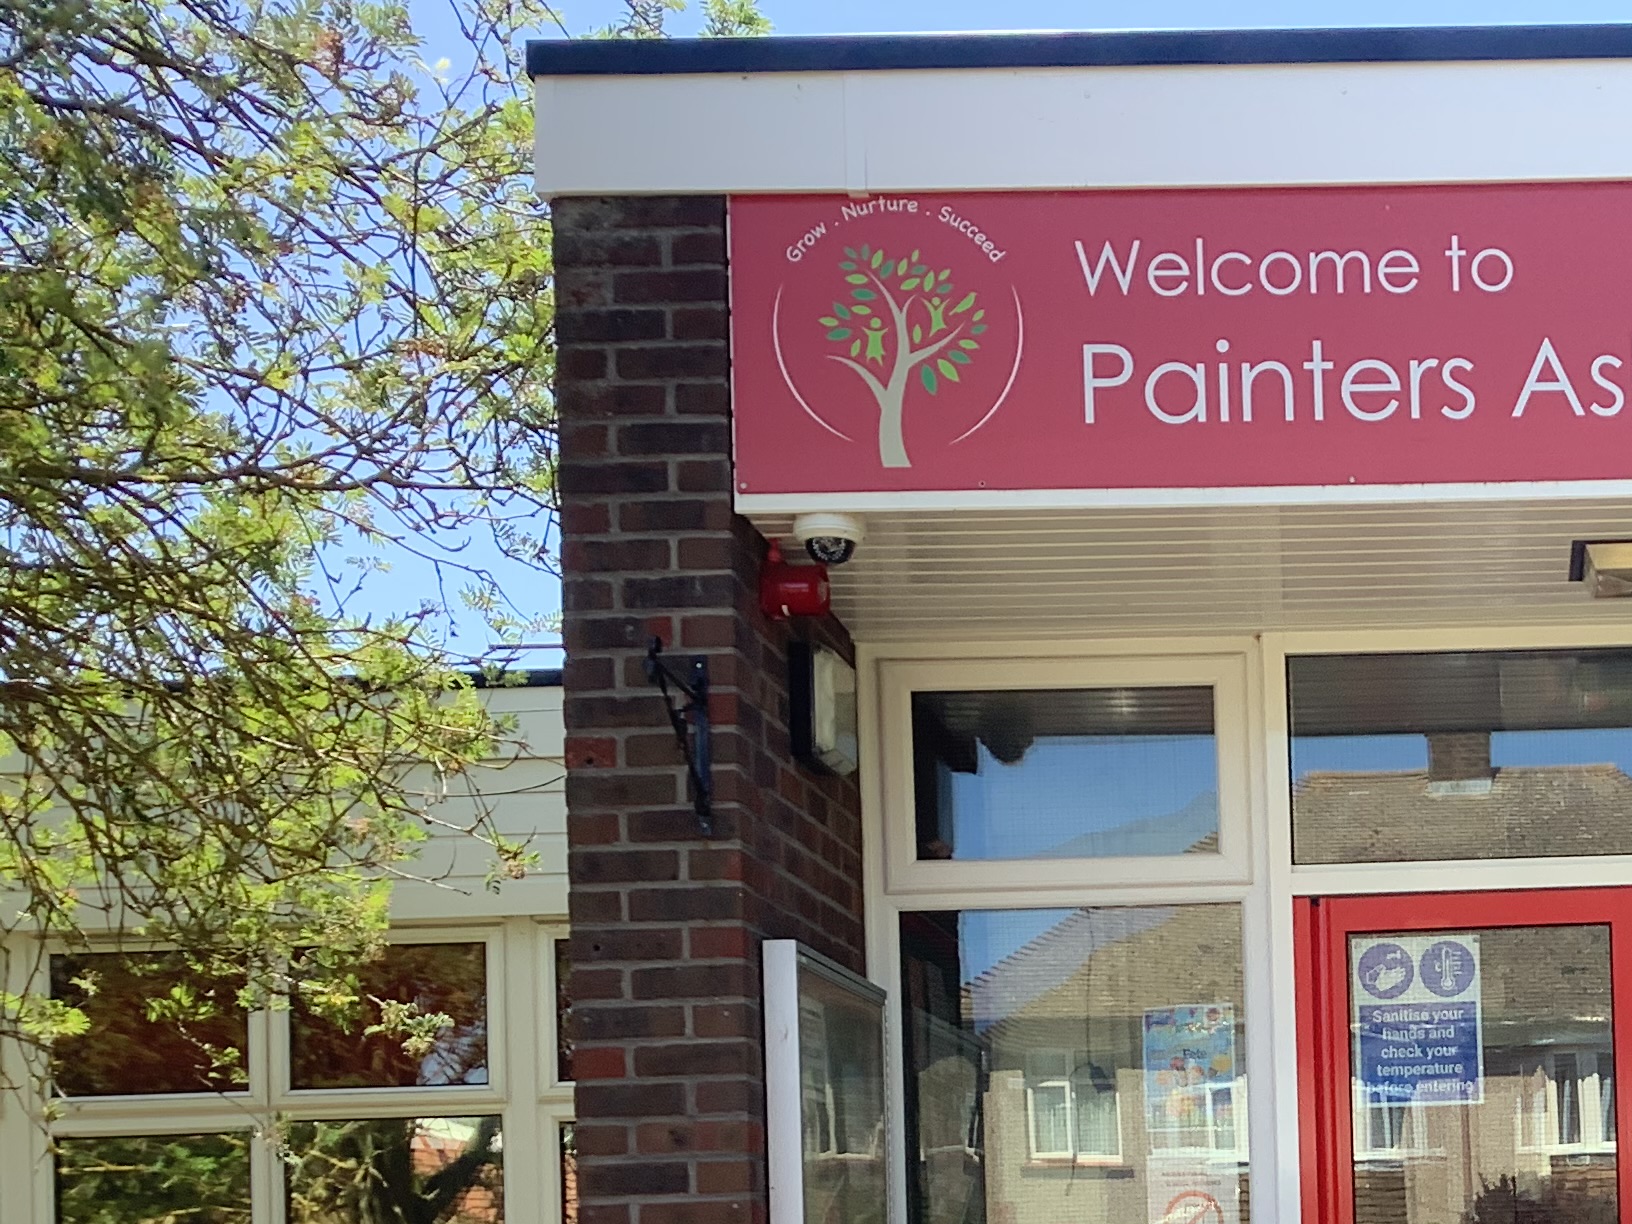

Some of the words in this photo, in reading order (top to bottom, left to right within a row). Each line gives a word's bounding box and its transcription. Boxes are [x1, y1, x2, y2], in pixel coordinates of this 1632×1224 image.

[786, 222, 827, 262] Grow
[841, 195, 918, 221] Nurture
[938, 206, 1007, 263] Succeed
[1075, 238, 1420, 297] Welcome
[1444, 235, 1514, 293] to
[1083, 339, 1476, 424] Painters
[1372, 1009, 1430, 1022] Sanitise
[1431, 1008, 1464, 1021] your
[1382, 1026, 1425, 1041] hands
[1429, 1025, 1455, 1039] and
[1380, 1045, 1424, 1059] check
[1426, 1045, 1458, 1060] your
[1376, 1062, 1464, 1077] temperature
[1416, 1079, 1474, 1095] entering
